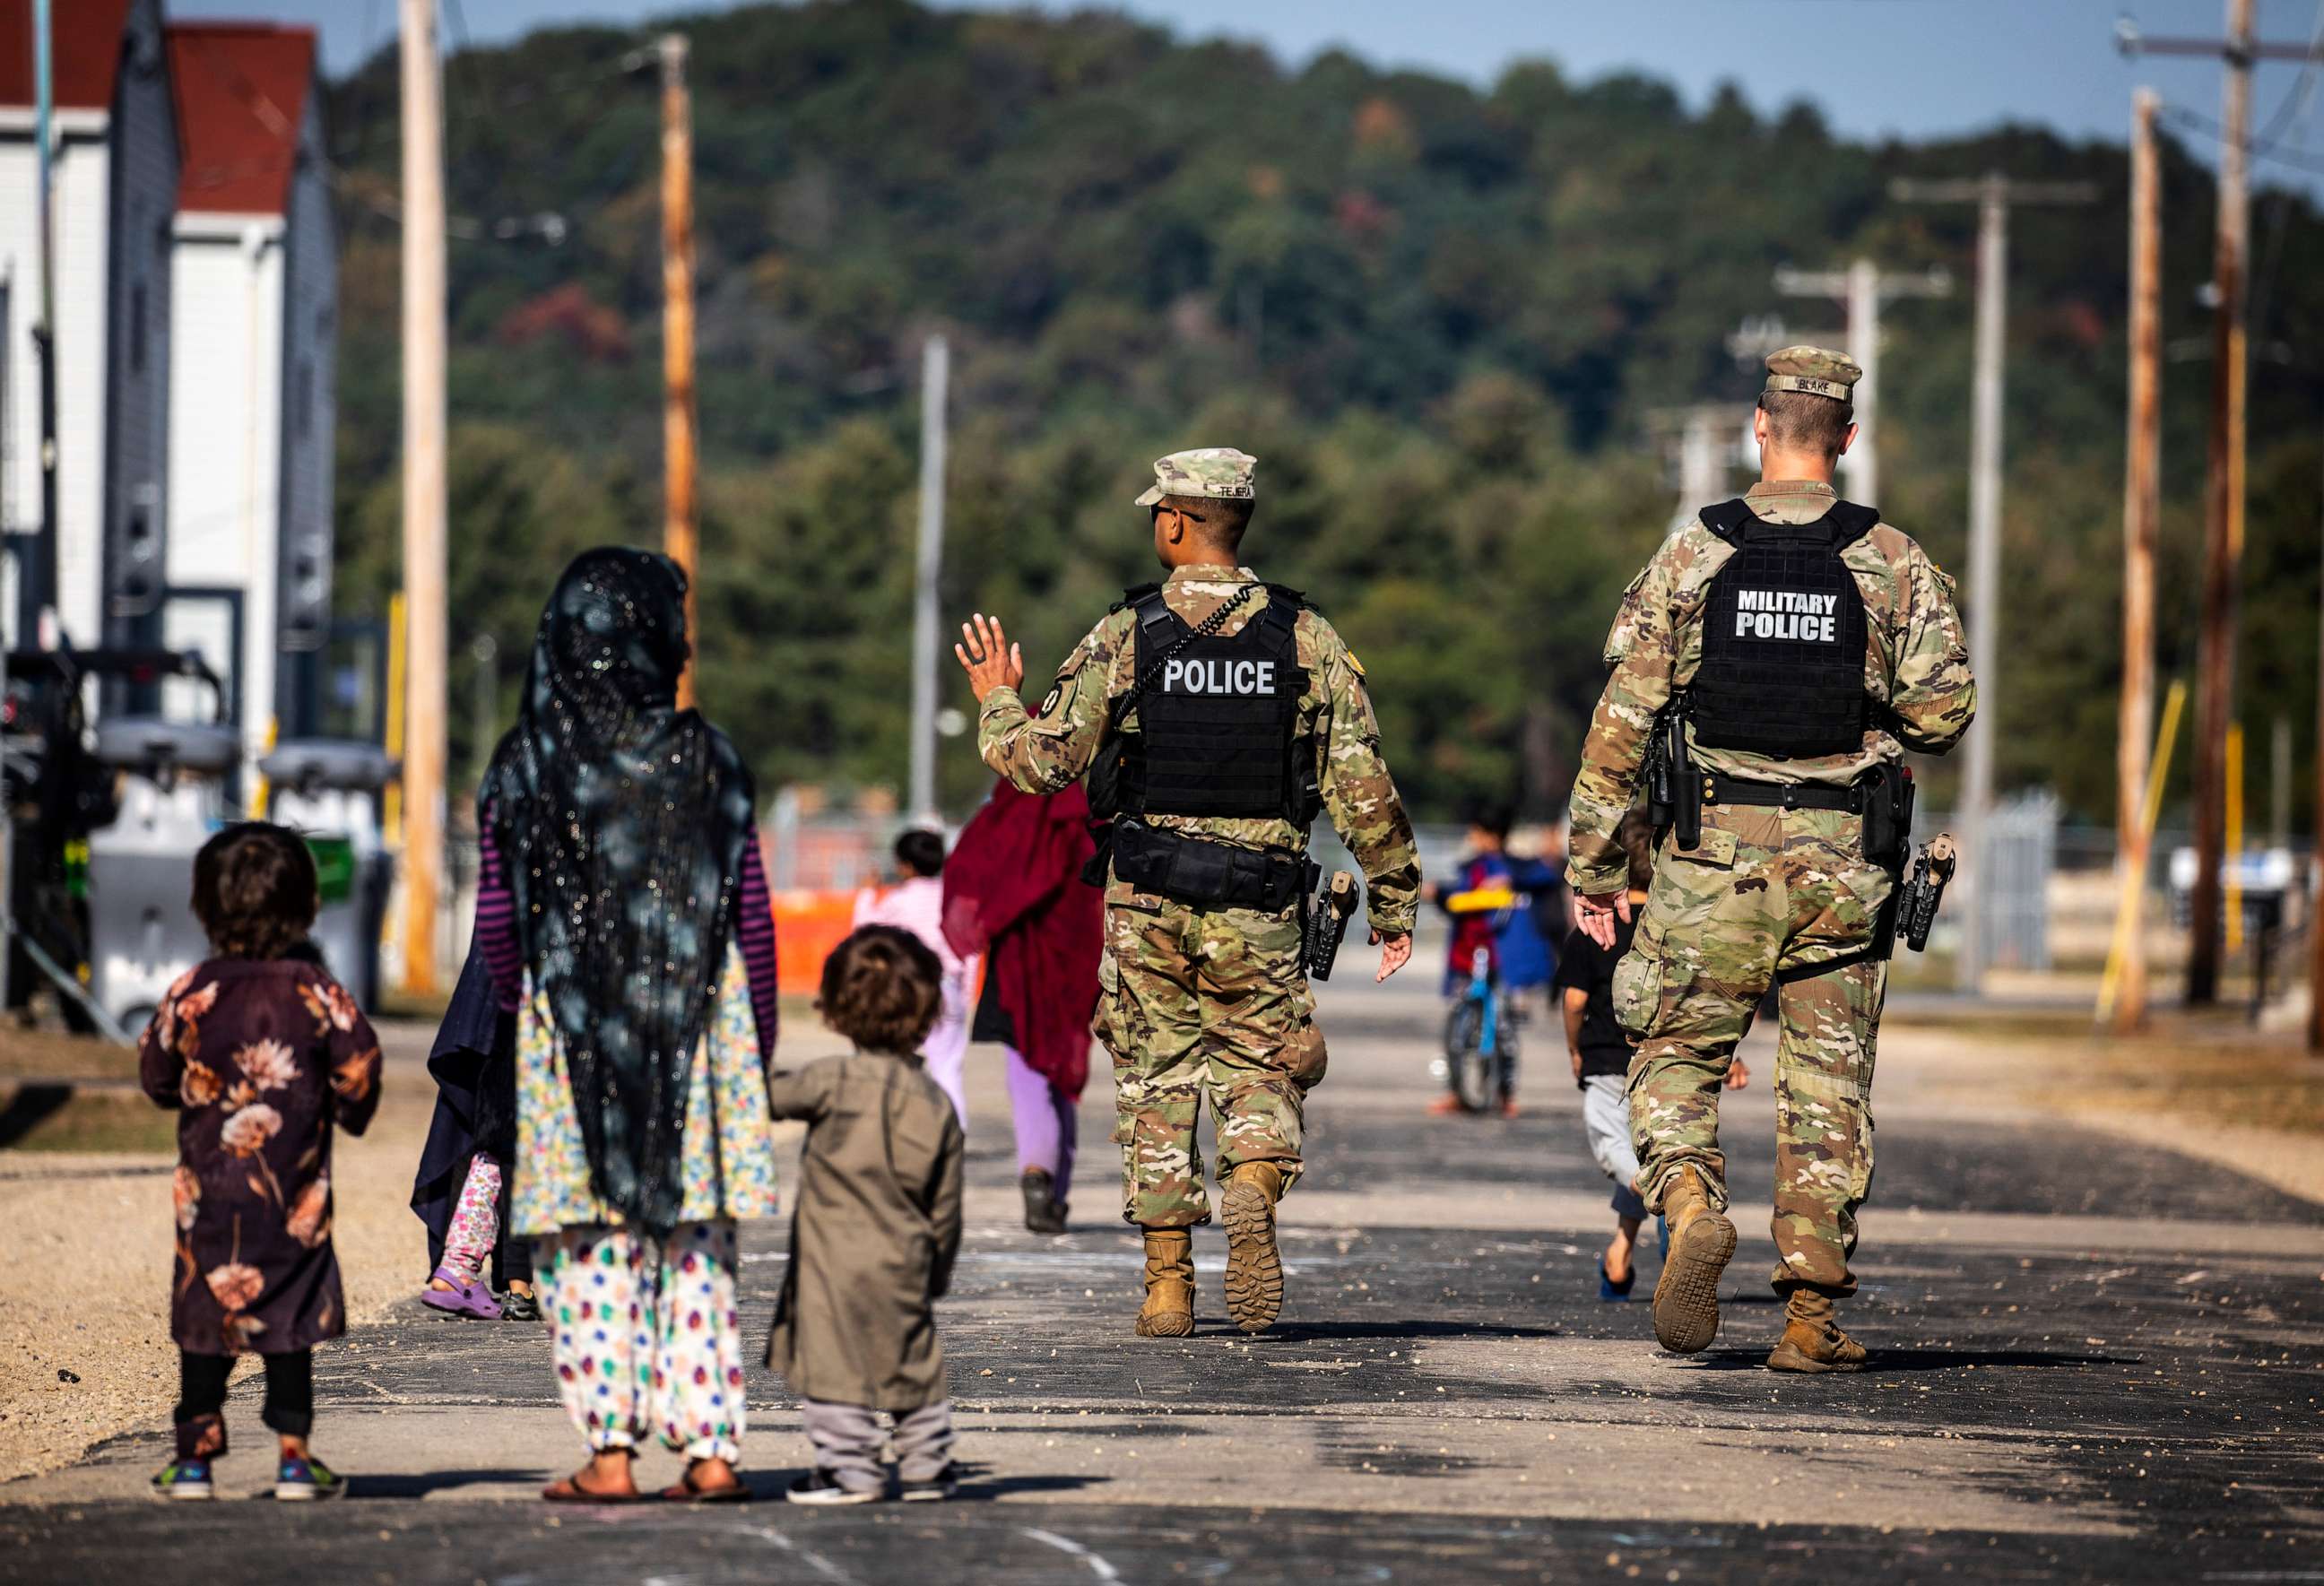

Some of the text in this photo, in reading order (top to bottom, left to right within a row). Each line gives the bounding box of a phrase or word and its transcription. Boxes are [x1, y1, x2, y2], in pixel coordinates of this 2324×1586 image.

[1799, 378, 1829, 394] BLAKE
[1738, 590, 1837, 615] MILITARY
[1736, 611, 1835, 642] POLICE
[1164, 659, 1275, 694] POLICE
